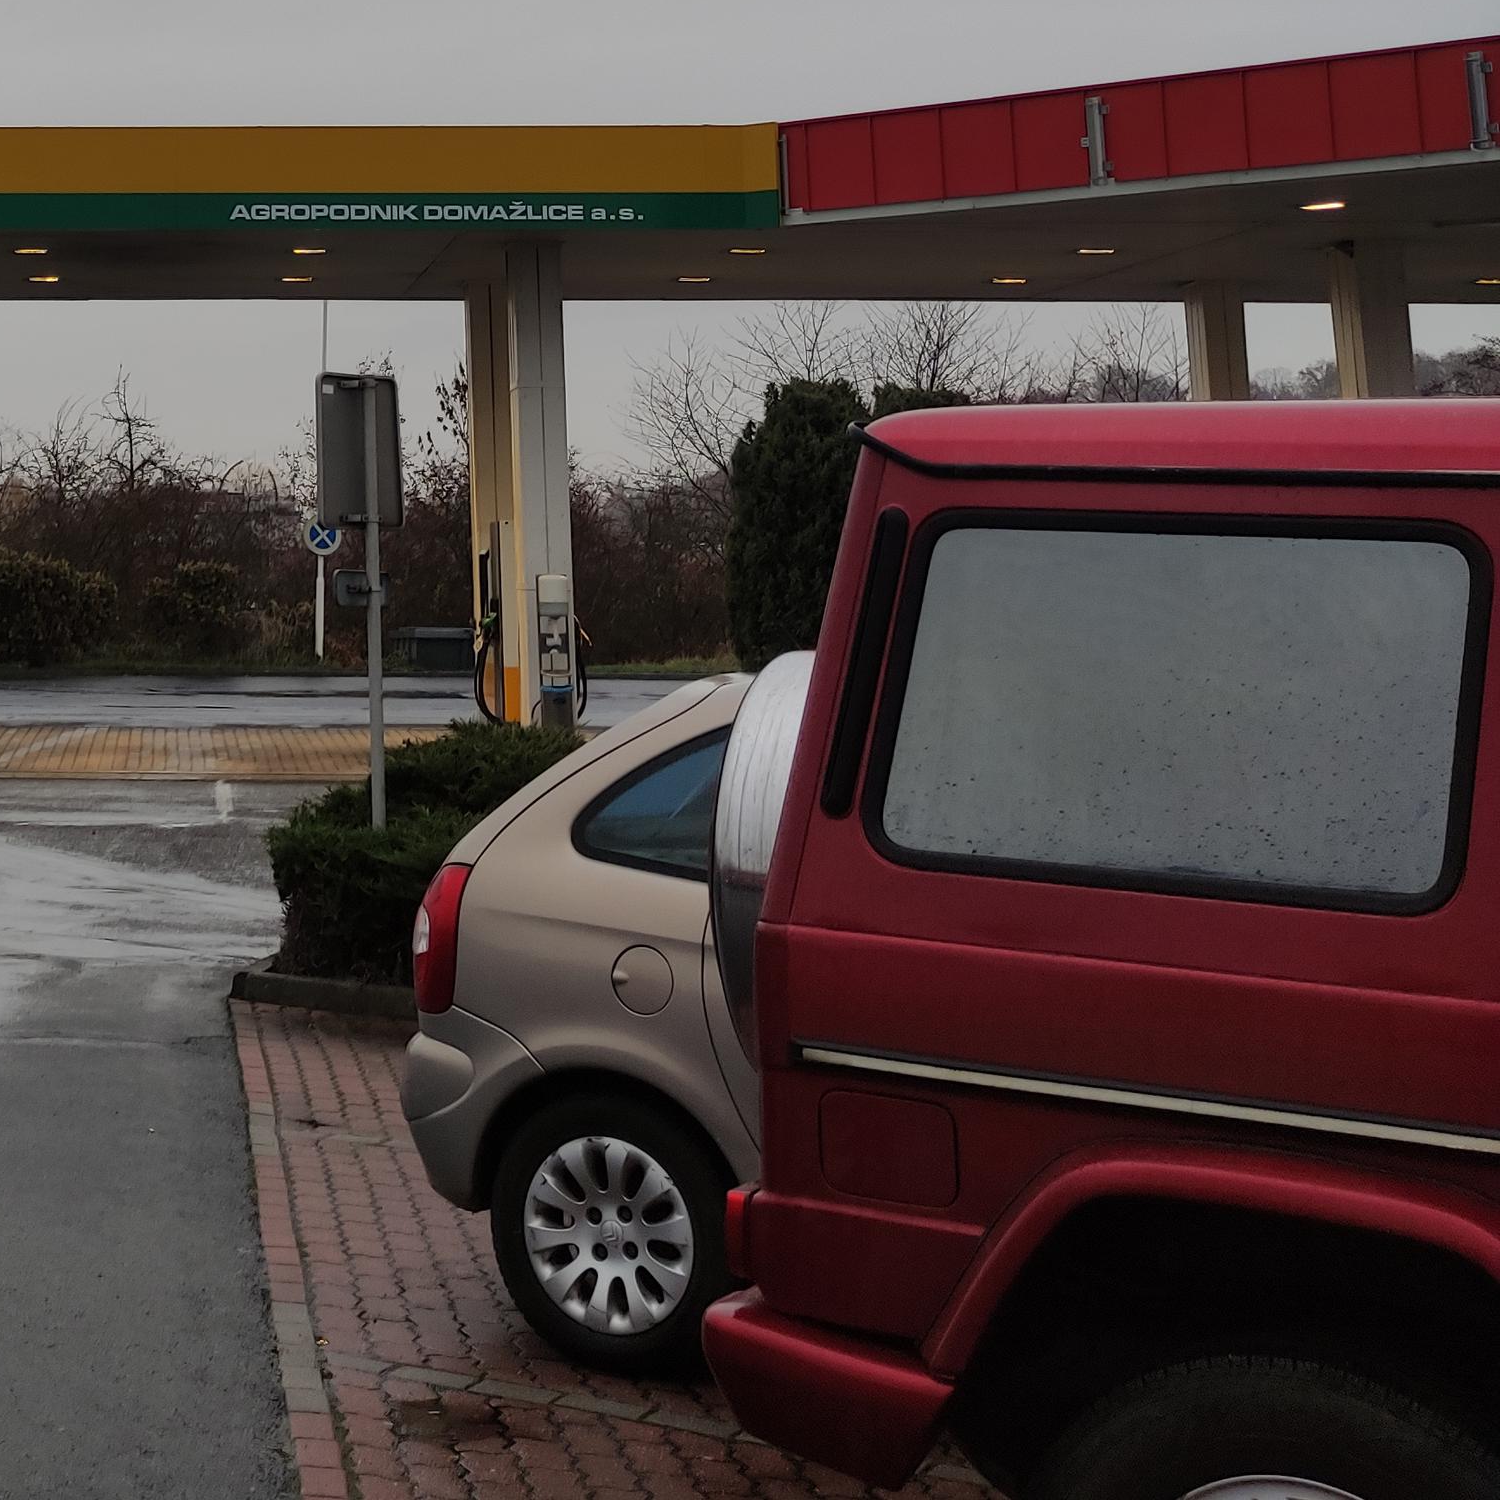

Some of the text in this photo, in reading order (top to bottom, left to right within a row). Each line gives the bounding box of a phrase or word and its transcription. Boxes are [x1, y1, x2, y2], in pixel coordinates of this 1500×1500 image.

[230, 201, 645, 221] AGROPODNIK DOMAŽLICE a.s.
